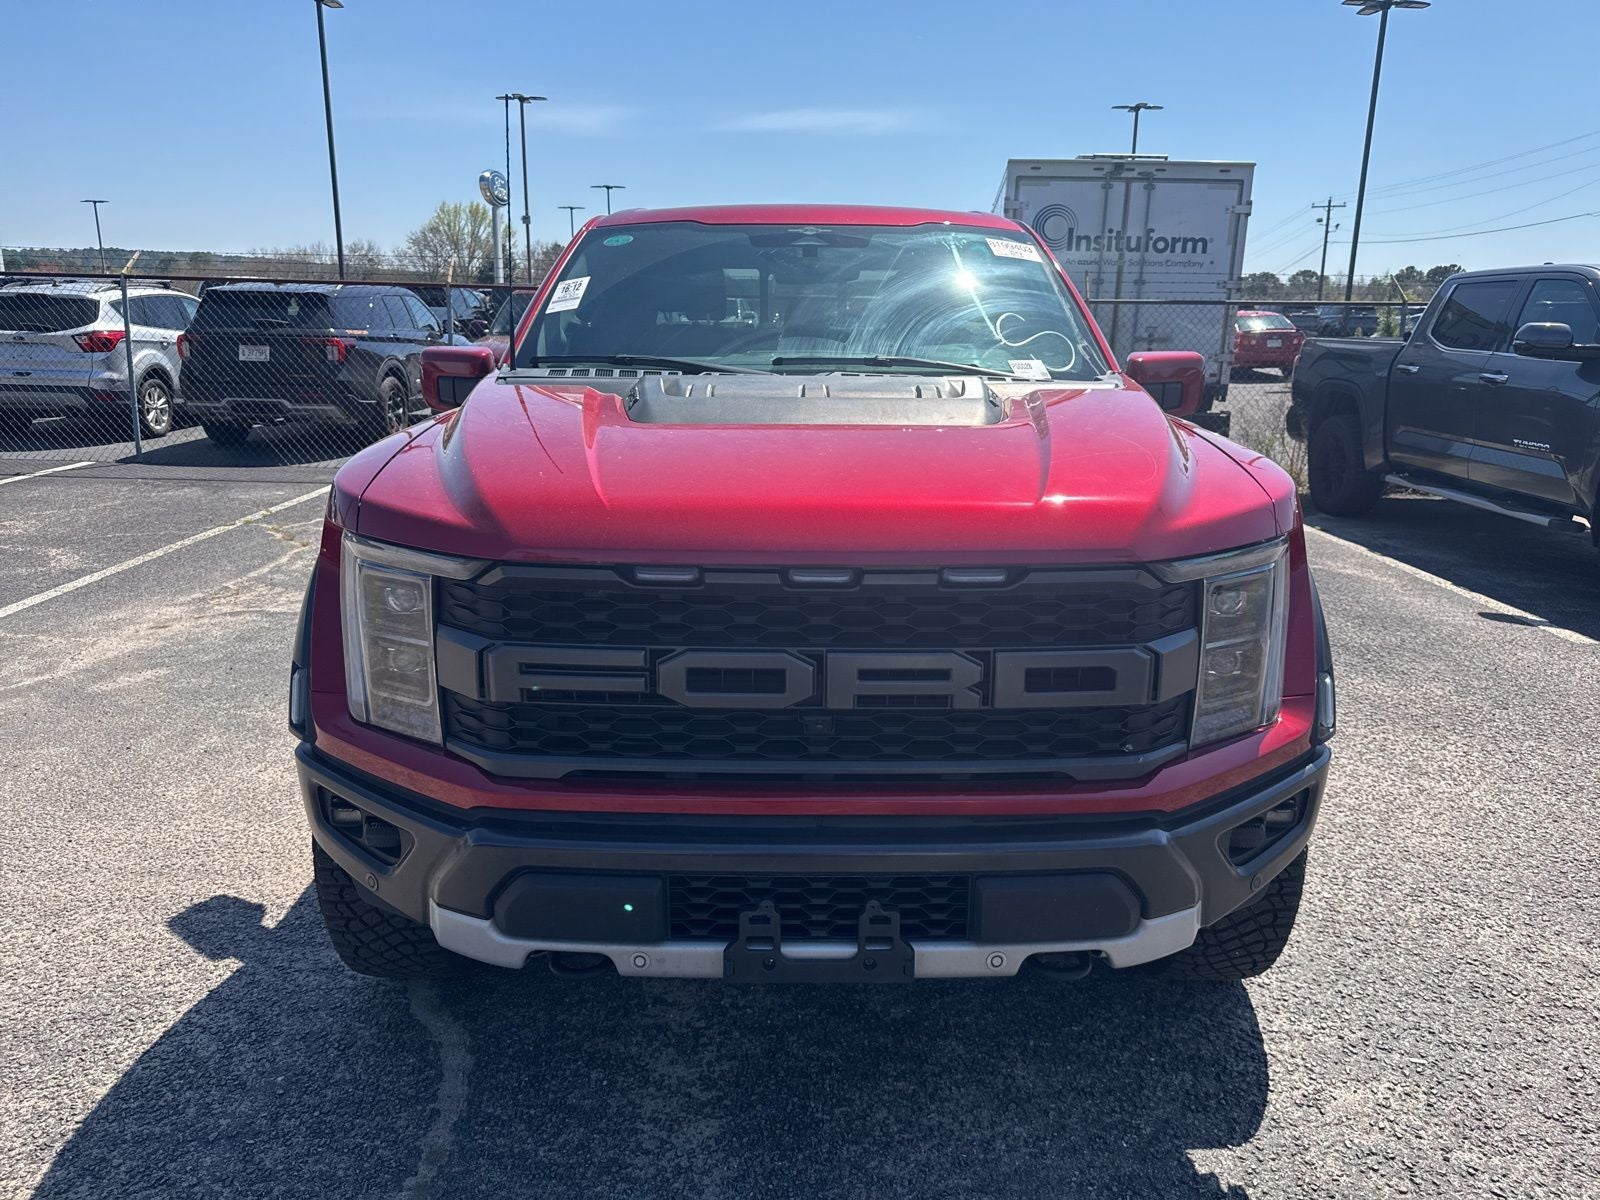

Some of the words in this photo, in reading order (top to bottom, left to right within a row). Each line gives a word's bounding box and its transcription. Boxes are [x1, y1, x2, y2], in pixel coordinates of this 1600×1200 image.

[1066, 227, 1208, 254] Insituform
[1165, 260, 1204, 268] Company
[484, 643, 1156, 711] FORD
